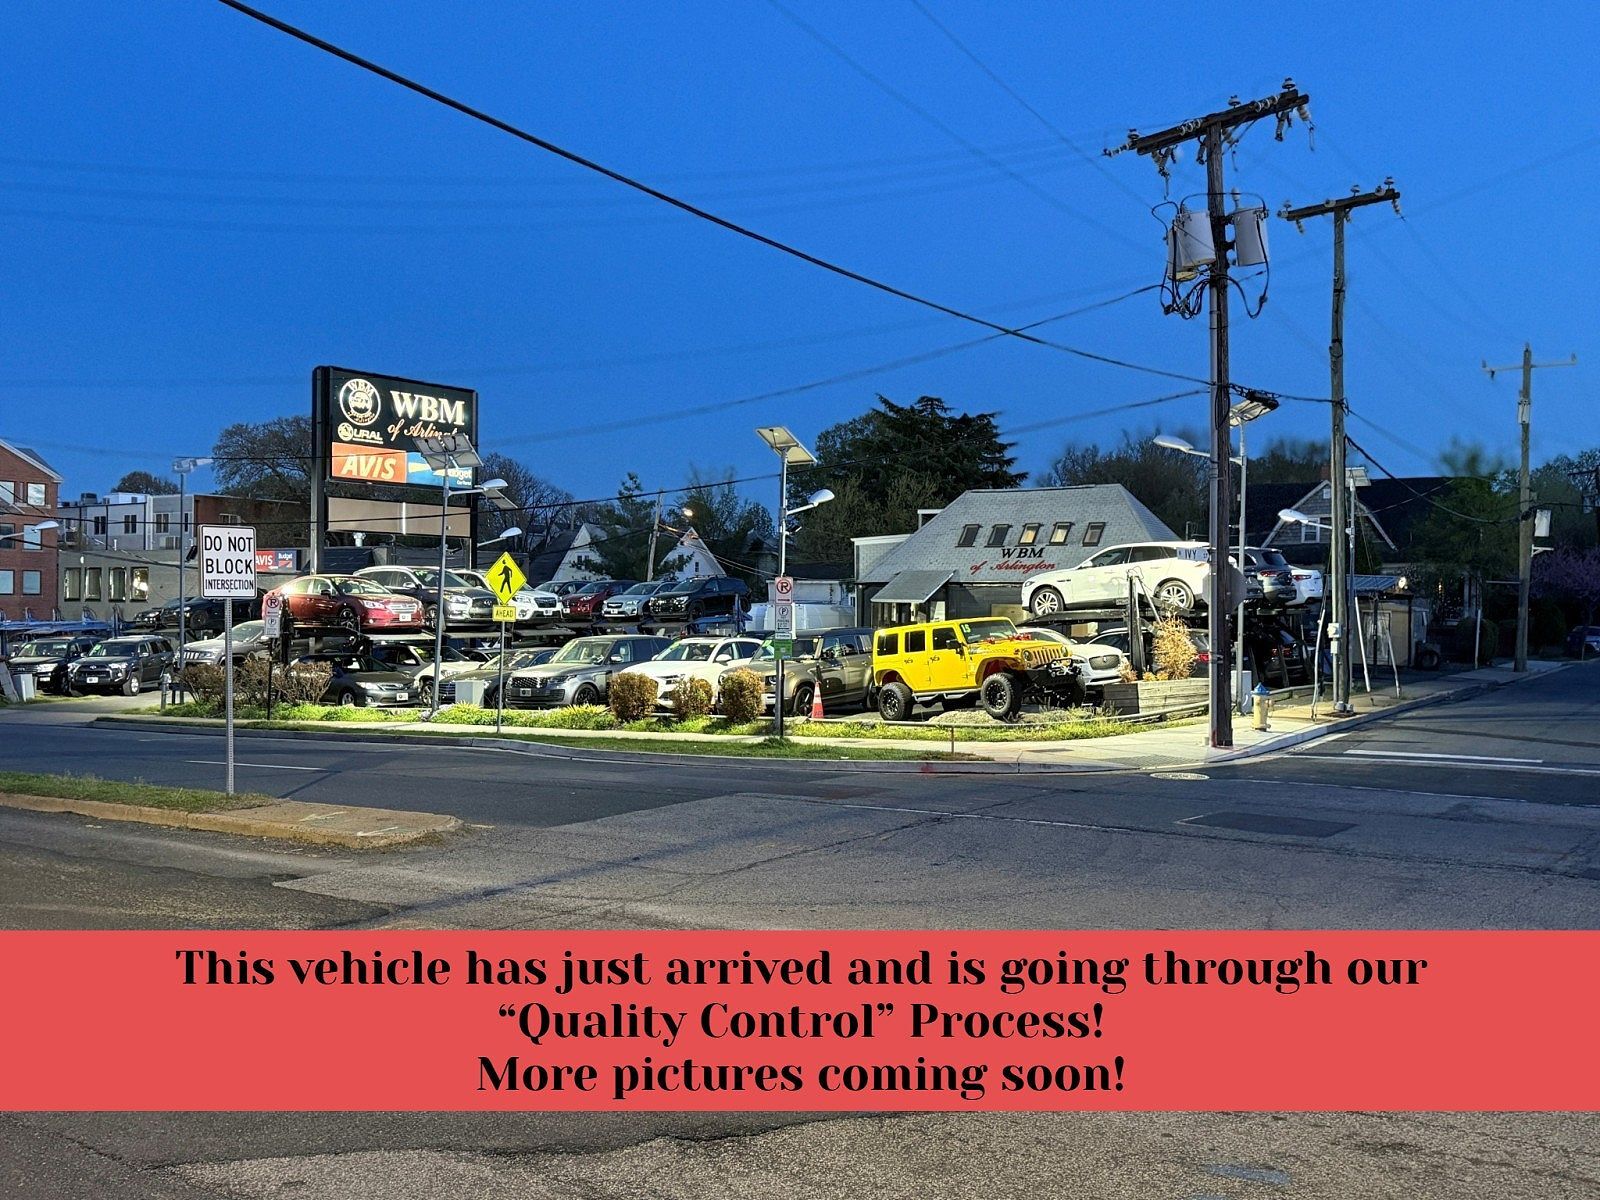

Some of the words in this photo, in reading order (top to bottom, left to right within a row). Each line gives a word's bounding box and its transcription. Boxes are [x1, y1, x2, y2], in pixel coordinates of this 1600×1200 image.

[390, 390, 465, 426] WBM
[353, 428, 383, 441] URAL
[387, 419, 405, 442] of
[340, 453, 397, 480] AVIS
[204, 535, 222, 551] DO
[228, 537, 253, 552] NOT
[255, 555, 273, 566] AVIS
[278, 552, 293, 560] Budget
[1001, 547, 1046, 559] WBM
[1185, 548, 1197, 560] IVY
[205, 558, 253, 574] BLOCK
[970, 560, 988, 576] of
[990, 560, 1057, 574] Arlington
[205, 579, 254, 590] INTERSECTION
[495, 610, 514, 618] AHEAD
[960, 623, 971, 633] 15
